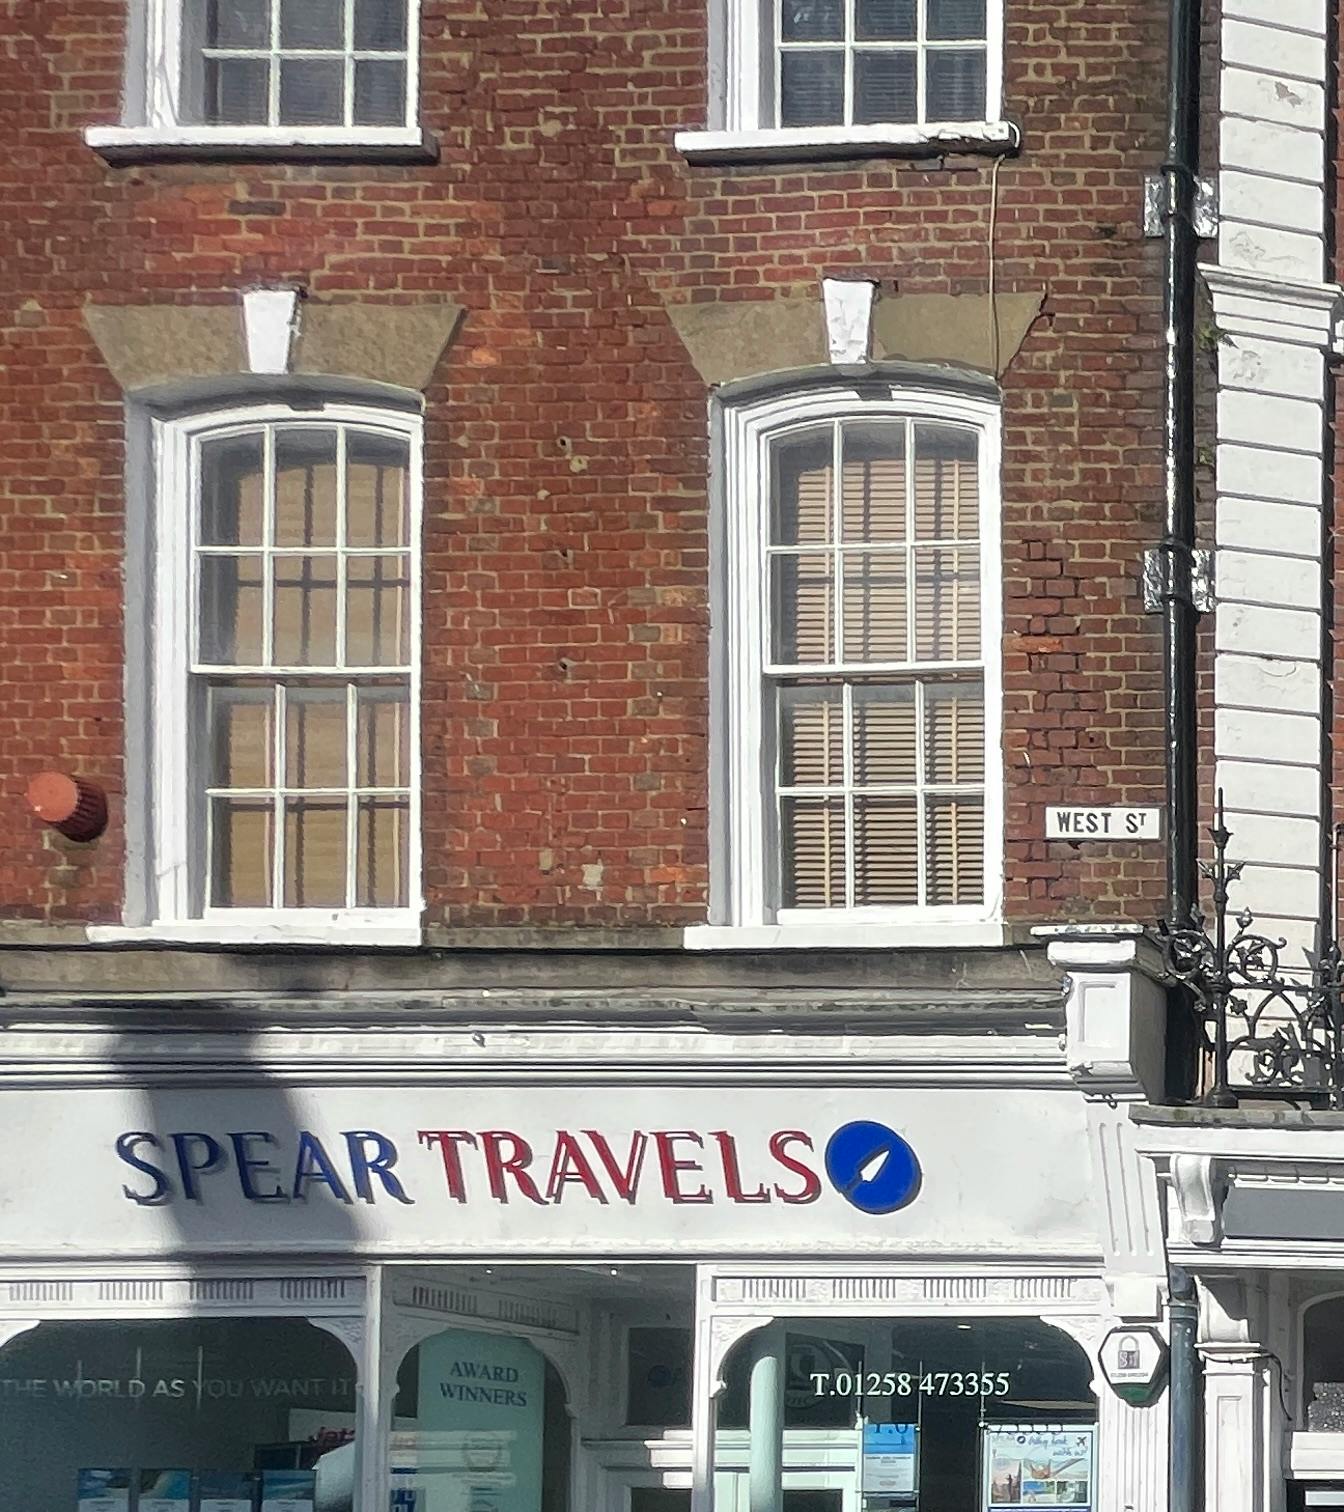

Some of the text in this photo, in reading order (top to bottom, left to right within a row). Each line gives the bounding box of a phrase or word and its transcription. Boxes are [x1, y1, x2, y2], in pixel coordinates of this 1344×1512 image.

[1057, 811, 1112, 833] WEST
[115, 1130, 822, 1206] SPEAR TRAVELS
[451, 1361, 519, 1383] AWARD
[2, 1379, 47, 1398] THE
[53, 1378, 145, 1398] WORLD
[152, 1379, 185, 1398] AS
[193, 1378, 243, 1399] YOU
[250, 1377, 329, 1397] WANT
[440, 1382, 528, 1408] WINNERS
[810, 1373, 1010, 1396] T.01258 473355
